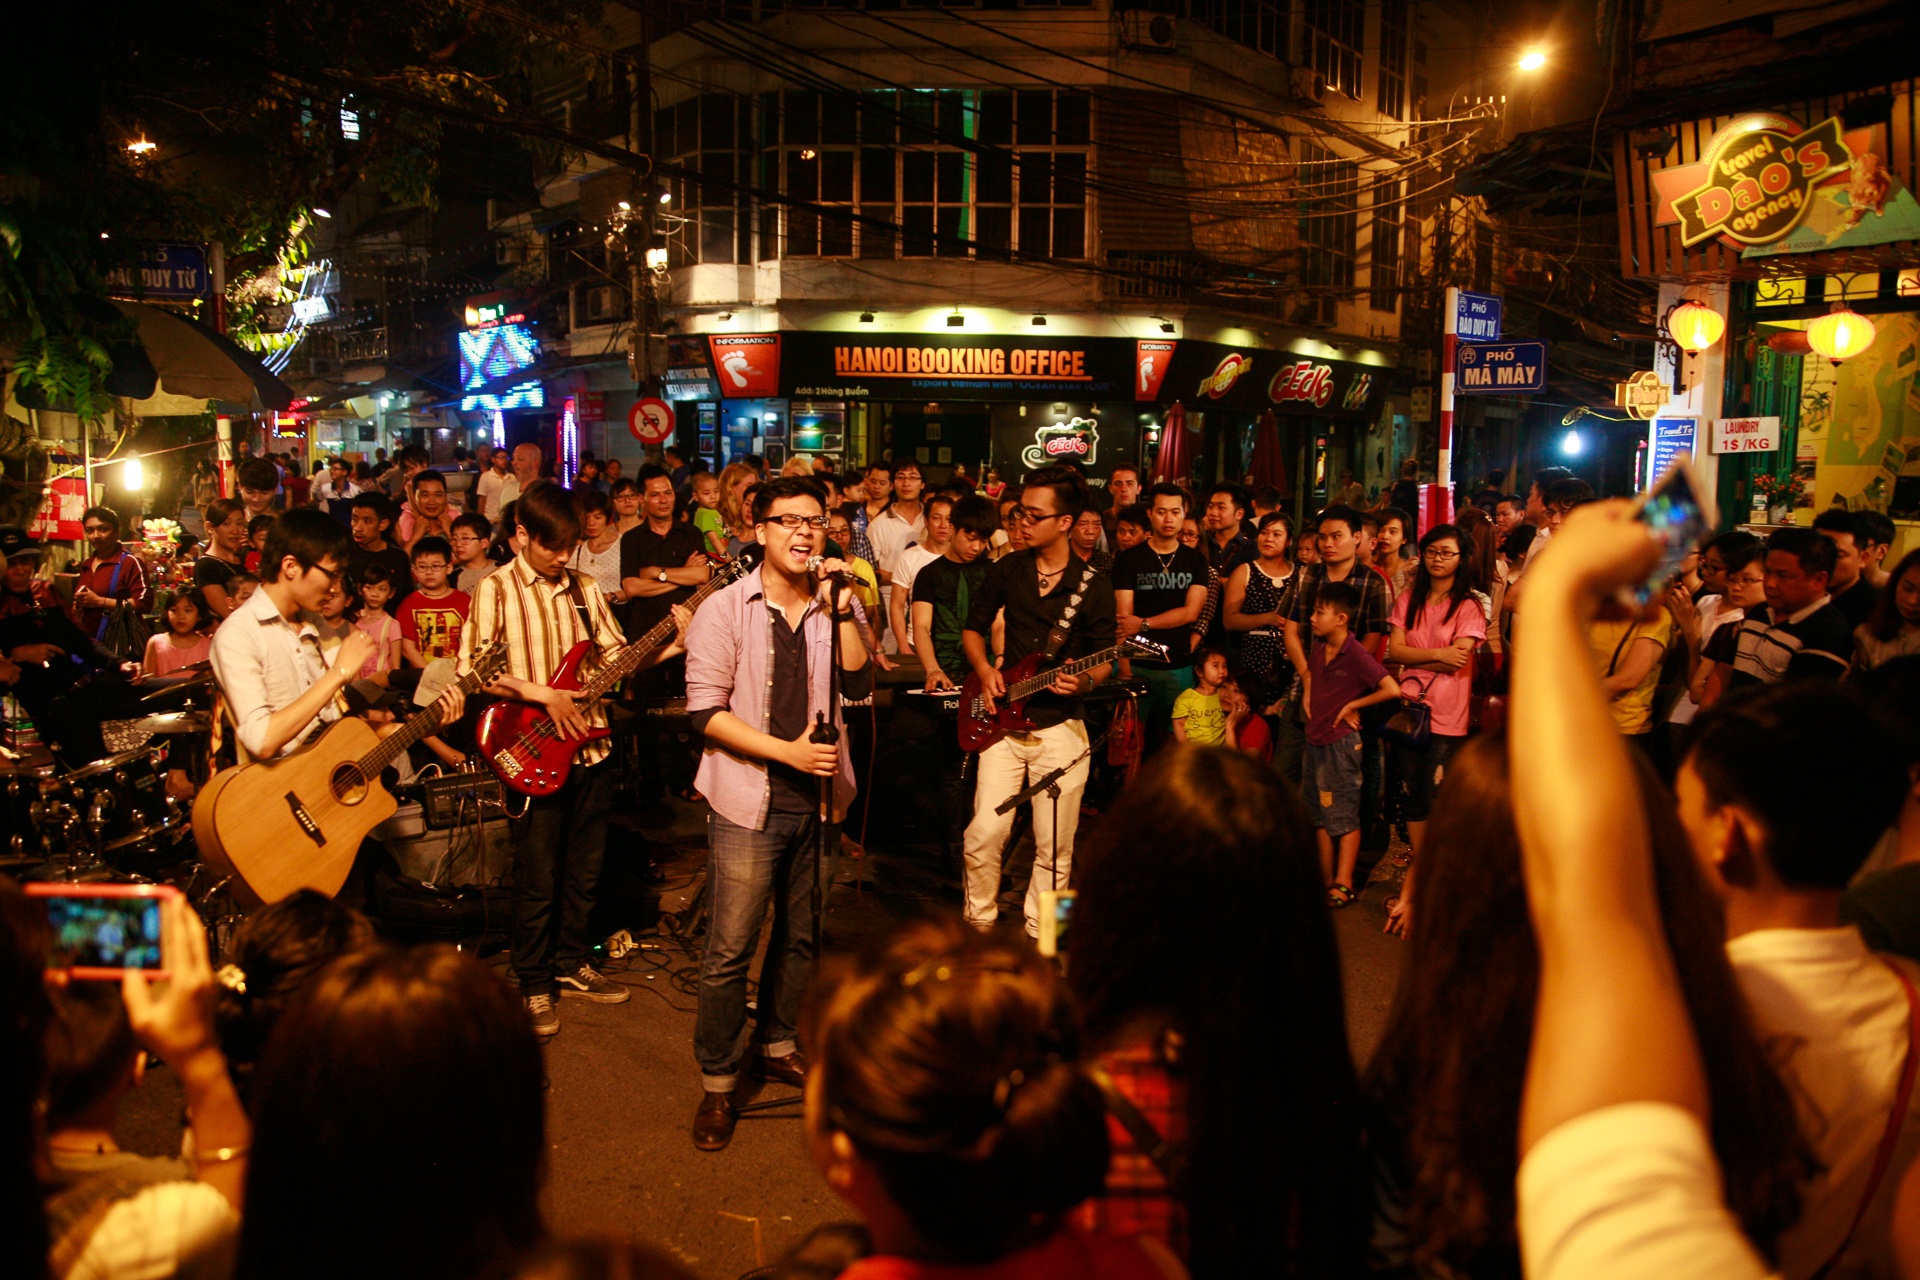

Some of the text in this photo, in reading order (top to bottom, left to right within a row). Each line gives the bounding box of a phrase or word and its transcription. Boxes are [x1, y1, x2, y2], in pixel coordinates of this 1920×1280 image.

[1718, 135, 1775, 176] travel
[1695, 141, 1829, 229] Đào's
[1732, 188, 1802, 231] agency
[141, 268, 172, 288] DUY
[1471, 301, 1487, 314] PHỐ
[1473, 319, 1486, 336] DUY
[715, 337, 774, 345] INFORMATION
[835, 347, 1085, 376] HANOI BOOKING OFFICE
[1486, 347, 1515, 361] PHỐ
[1465, 362, 1536, 385] MÃ MÂY
[815, 387, 821, 395] 2
[1658, 424, 1694, 436] Travel To
[1725, 421, 1760, 435] LAUNDRY
[1722, 438, 1770, 451] 1$ /KG
[1137, 572, 1193, 590] PHOTOSHOP
